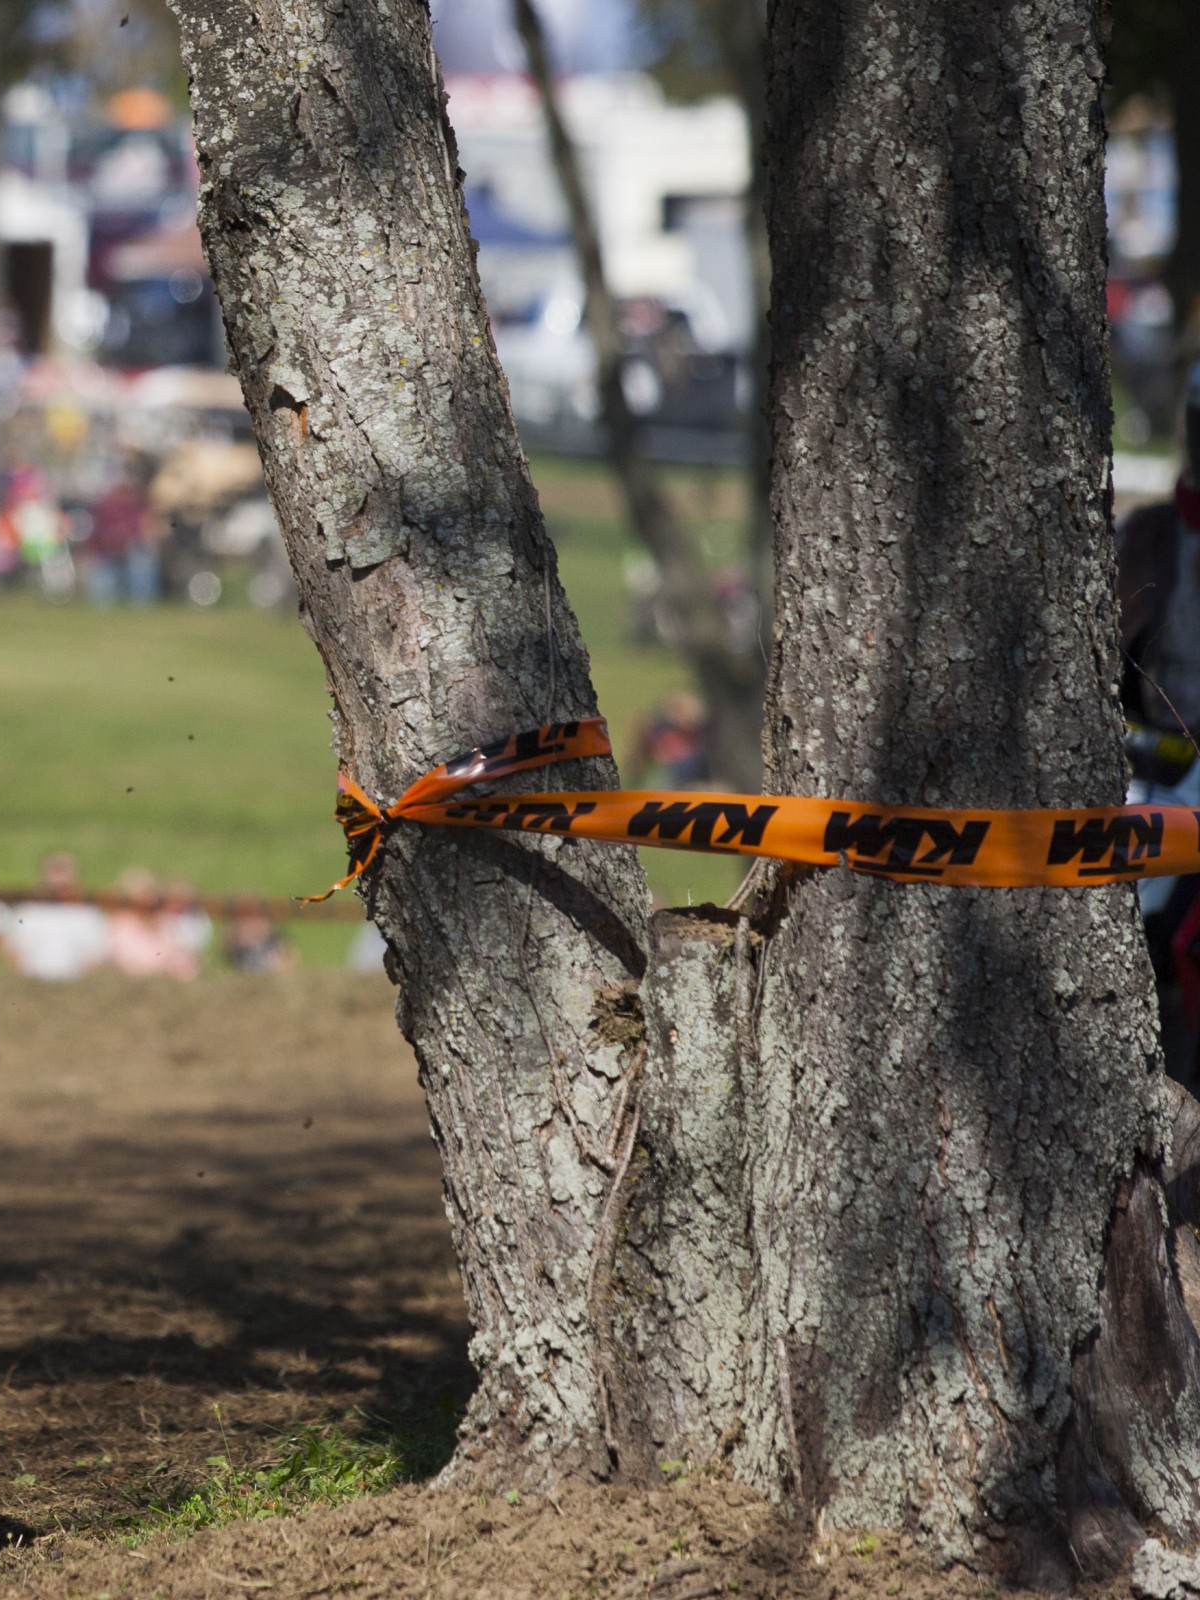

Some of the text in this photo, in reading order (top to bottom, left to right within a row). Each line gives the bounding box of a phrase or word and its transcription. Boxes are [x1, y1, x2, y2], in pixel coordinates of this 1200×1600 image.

[627, 801, 780, 853] KTM
[823, 810, 992, 877] KTM
[1046, 812, 1164, 877] KTM
